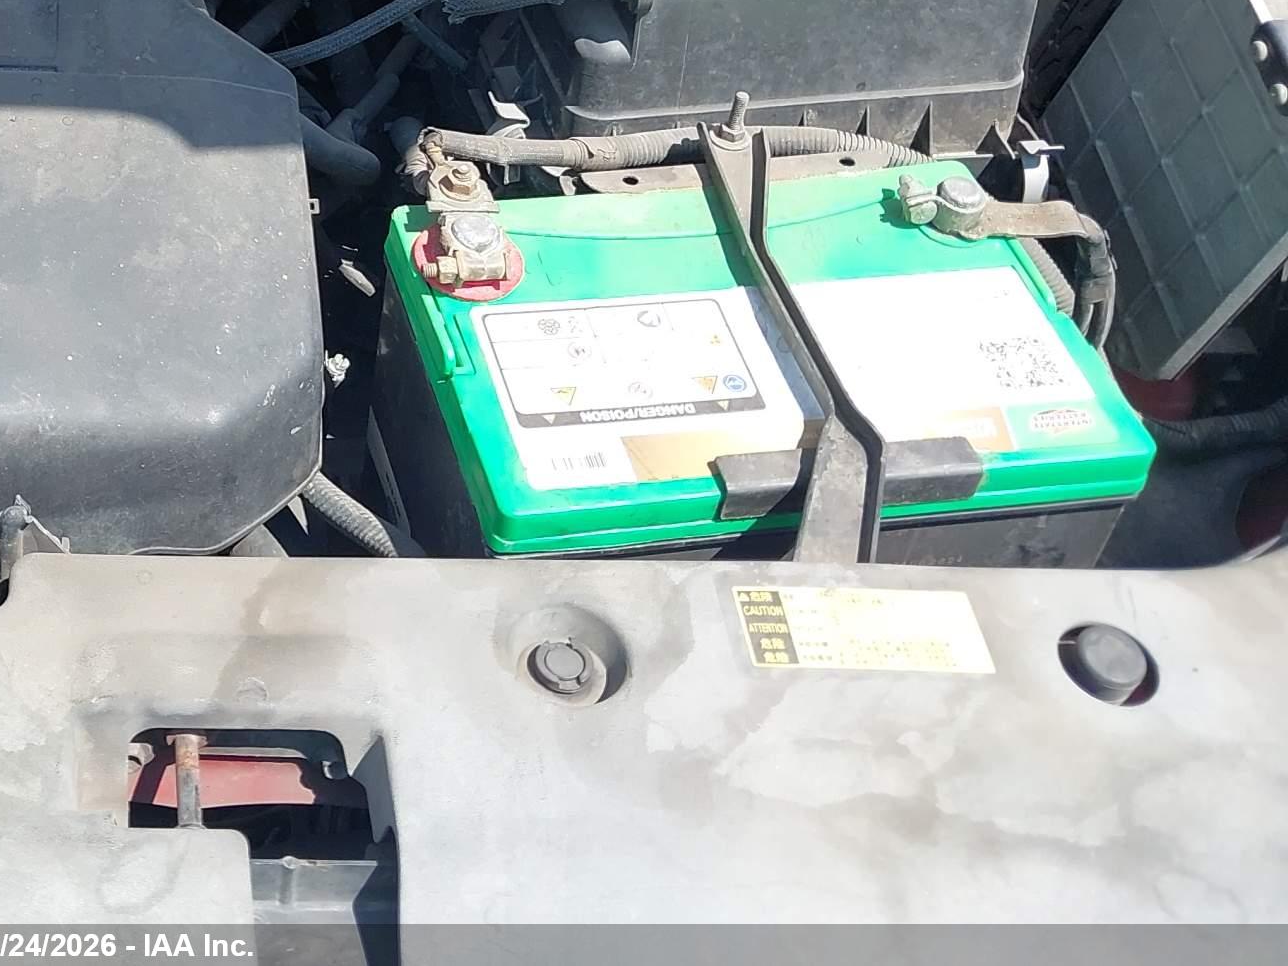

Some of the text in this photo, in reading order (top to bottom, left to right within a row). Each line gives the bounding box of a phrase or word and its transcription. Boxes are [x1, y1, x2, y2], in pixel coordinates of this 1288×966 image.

[579, 403, 696, 422] DANGER/POISON
[743, 605, 784, 616] CAUTION
[749, 622, 788, 634] ATTENTION
